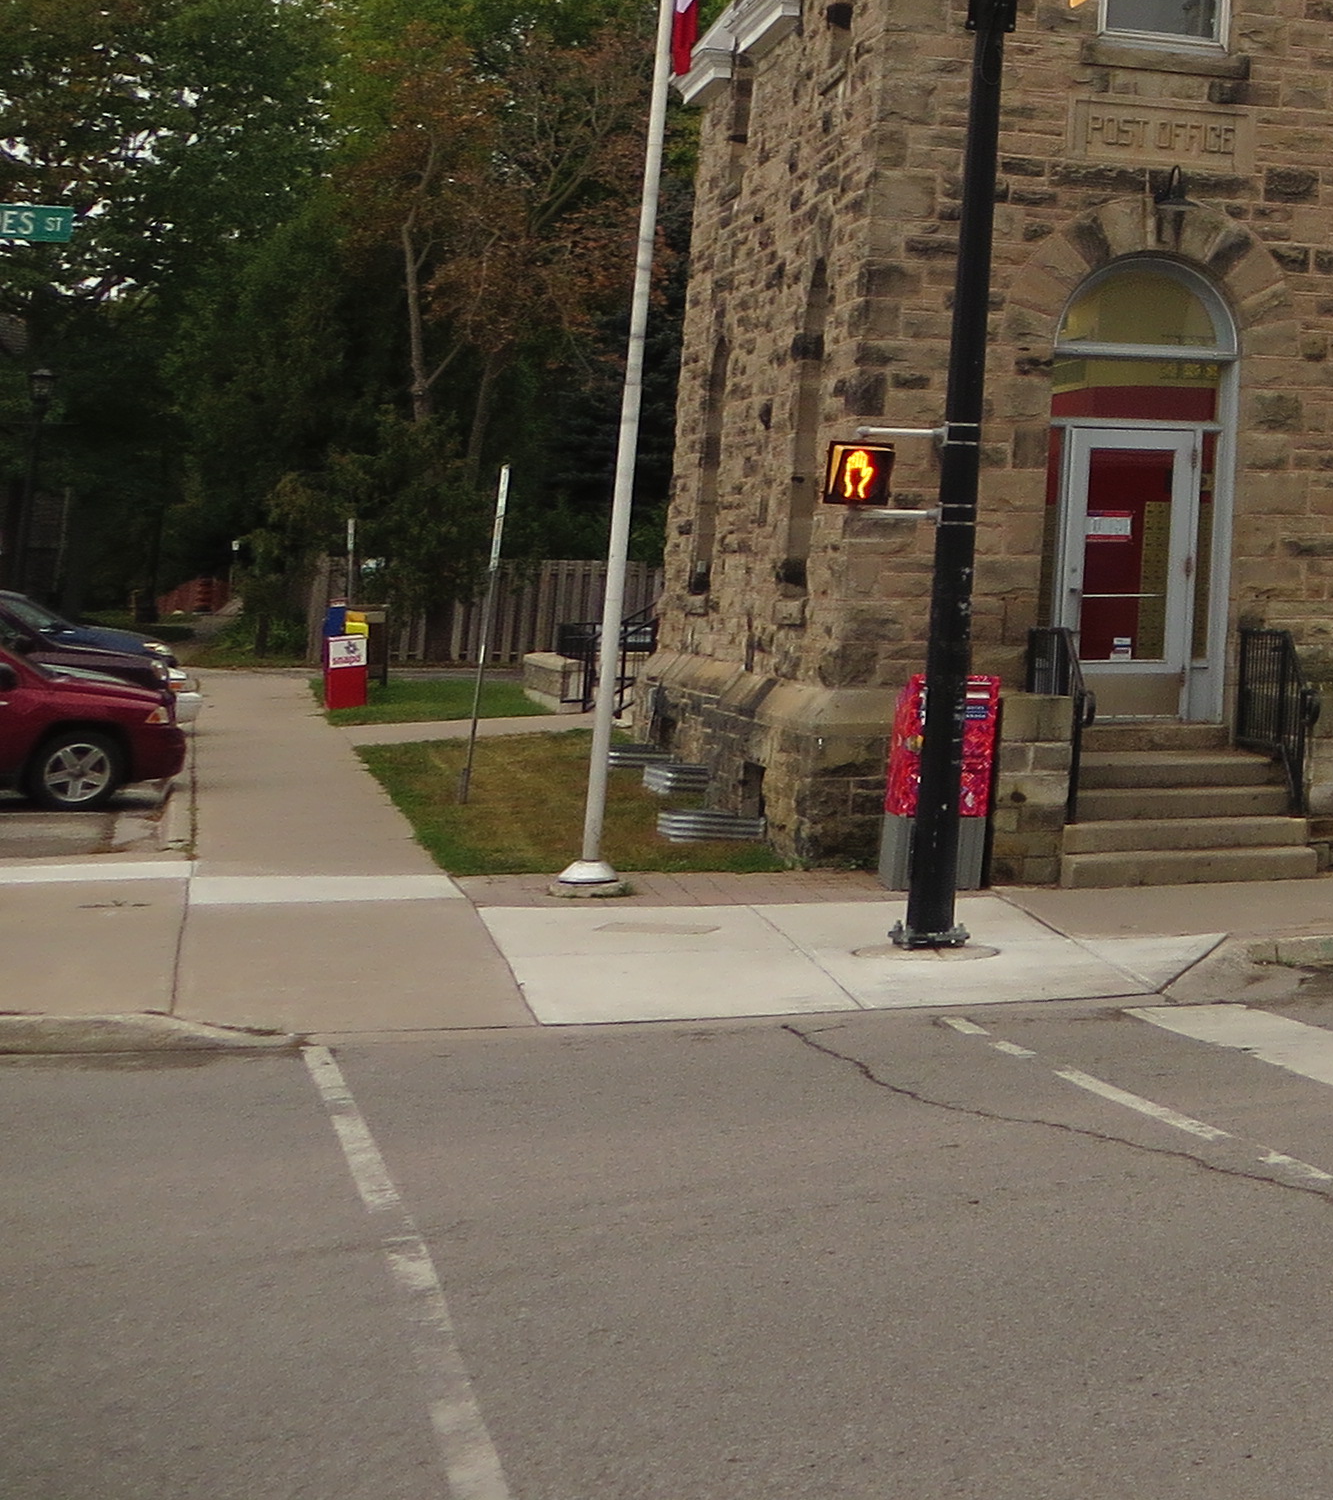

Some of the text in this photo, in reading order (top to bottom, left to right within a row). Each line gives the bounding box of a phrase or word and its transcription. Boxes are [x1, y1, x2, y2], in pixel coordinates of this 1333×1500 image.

[1087, 116, 1236, 155] POST OFFICE
[46, 217, 64, 231] ST
